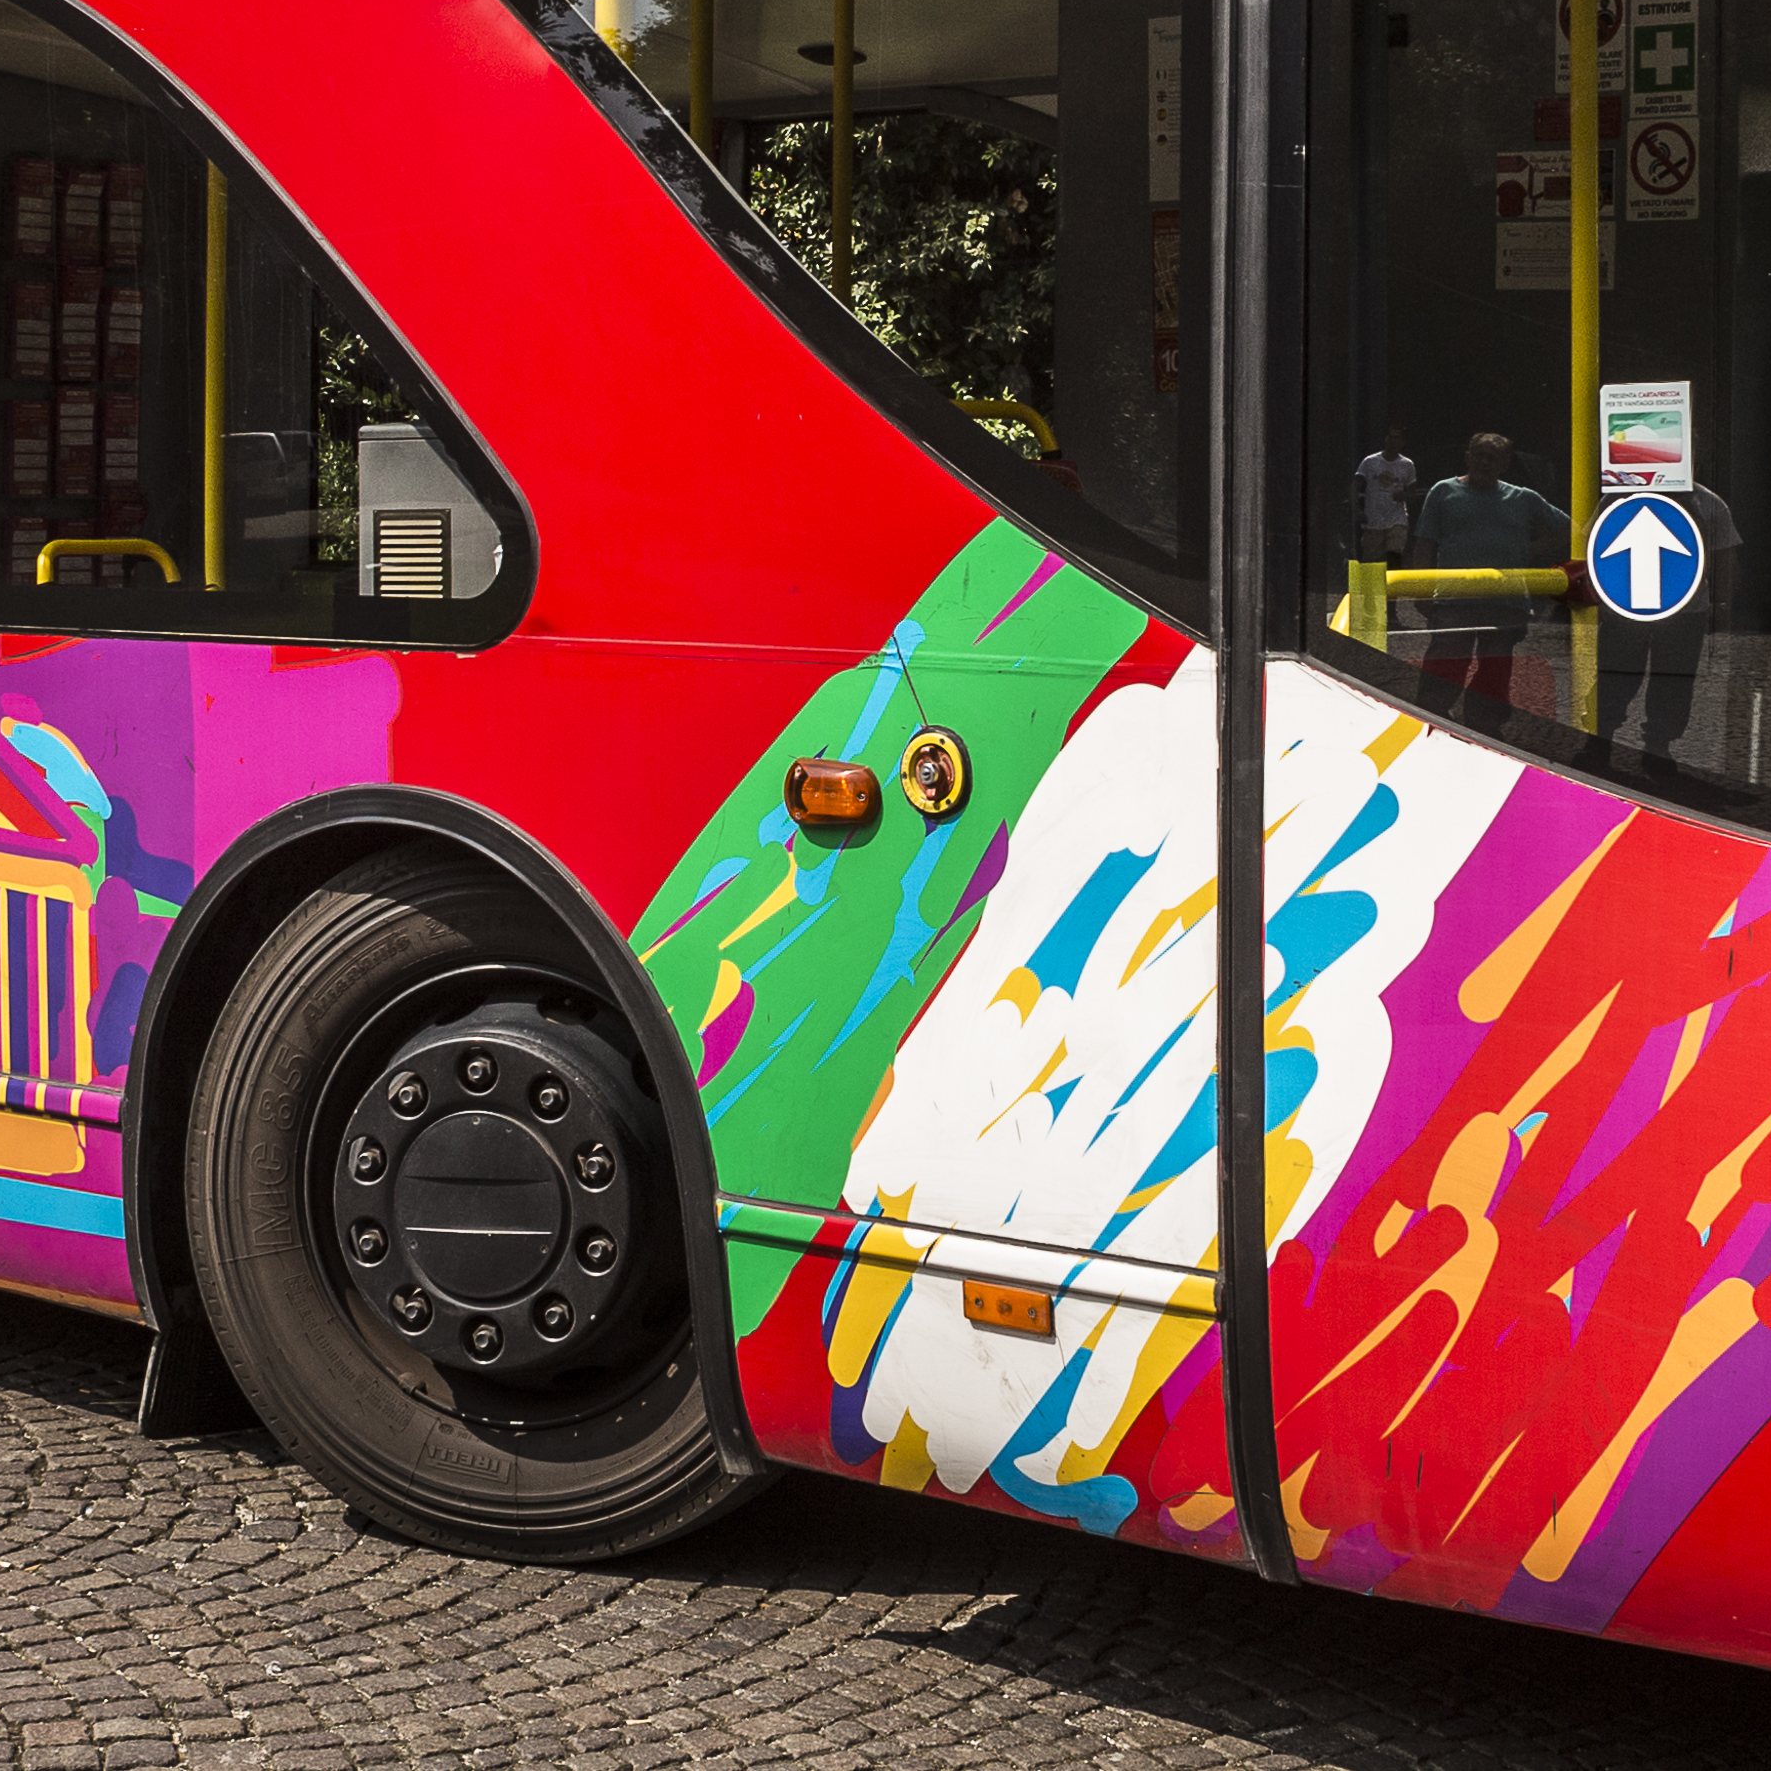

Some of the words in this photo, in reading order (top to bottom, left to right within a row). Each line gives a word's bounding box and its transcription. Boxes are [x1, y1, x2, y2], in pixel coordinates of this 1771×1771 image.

[1638, 1, 1692, 16] ESTINTORE
[1630, 198, 1661, 208] VIETATO
[1662, 198, 1696, 208] FUMARE
[1637, 210, 1649, 219] NO
[1650, 209, 1688, 218] SMOKING
